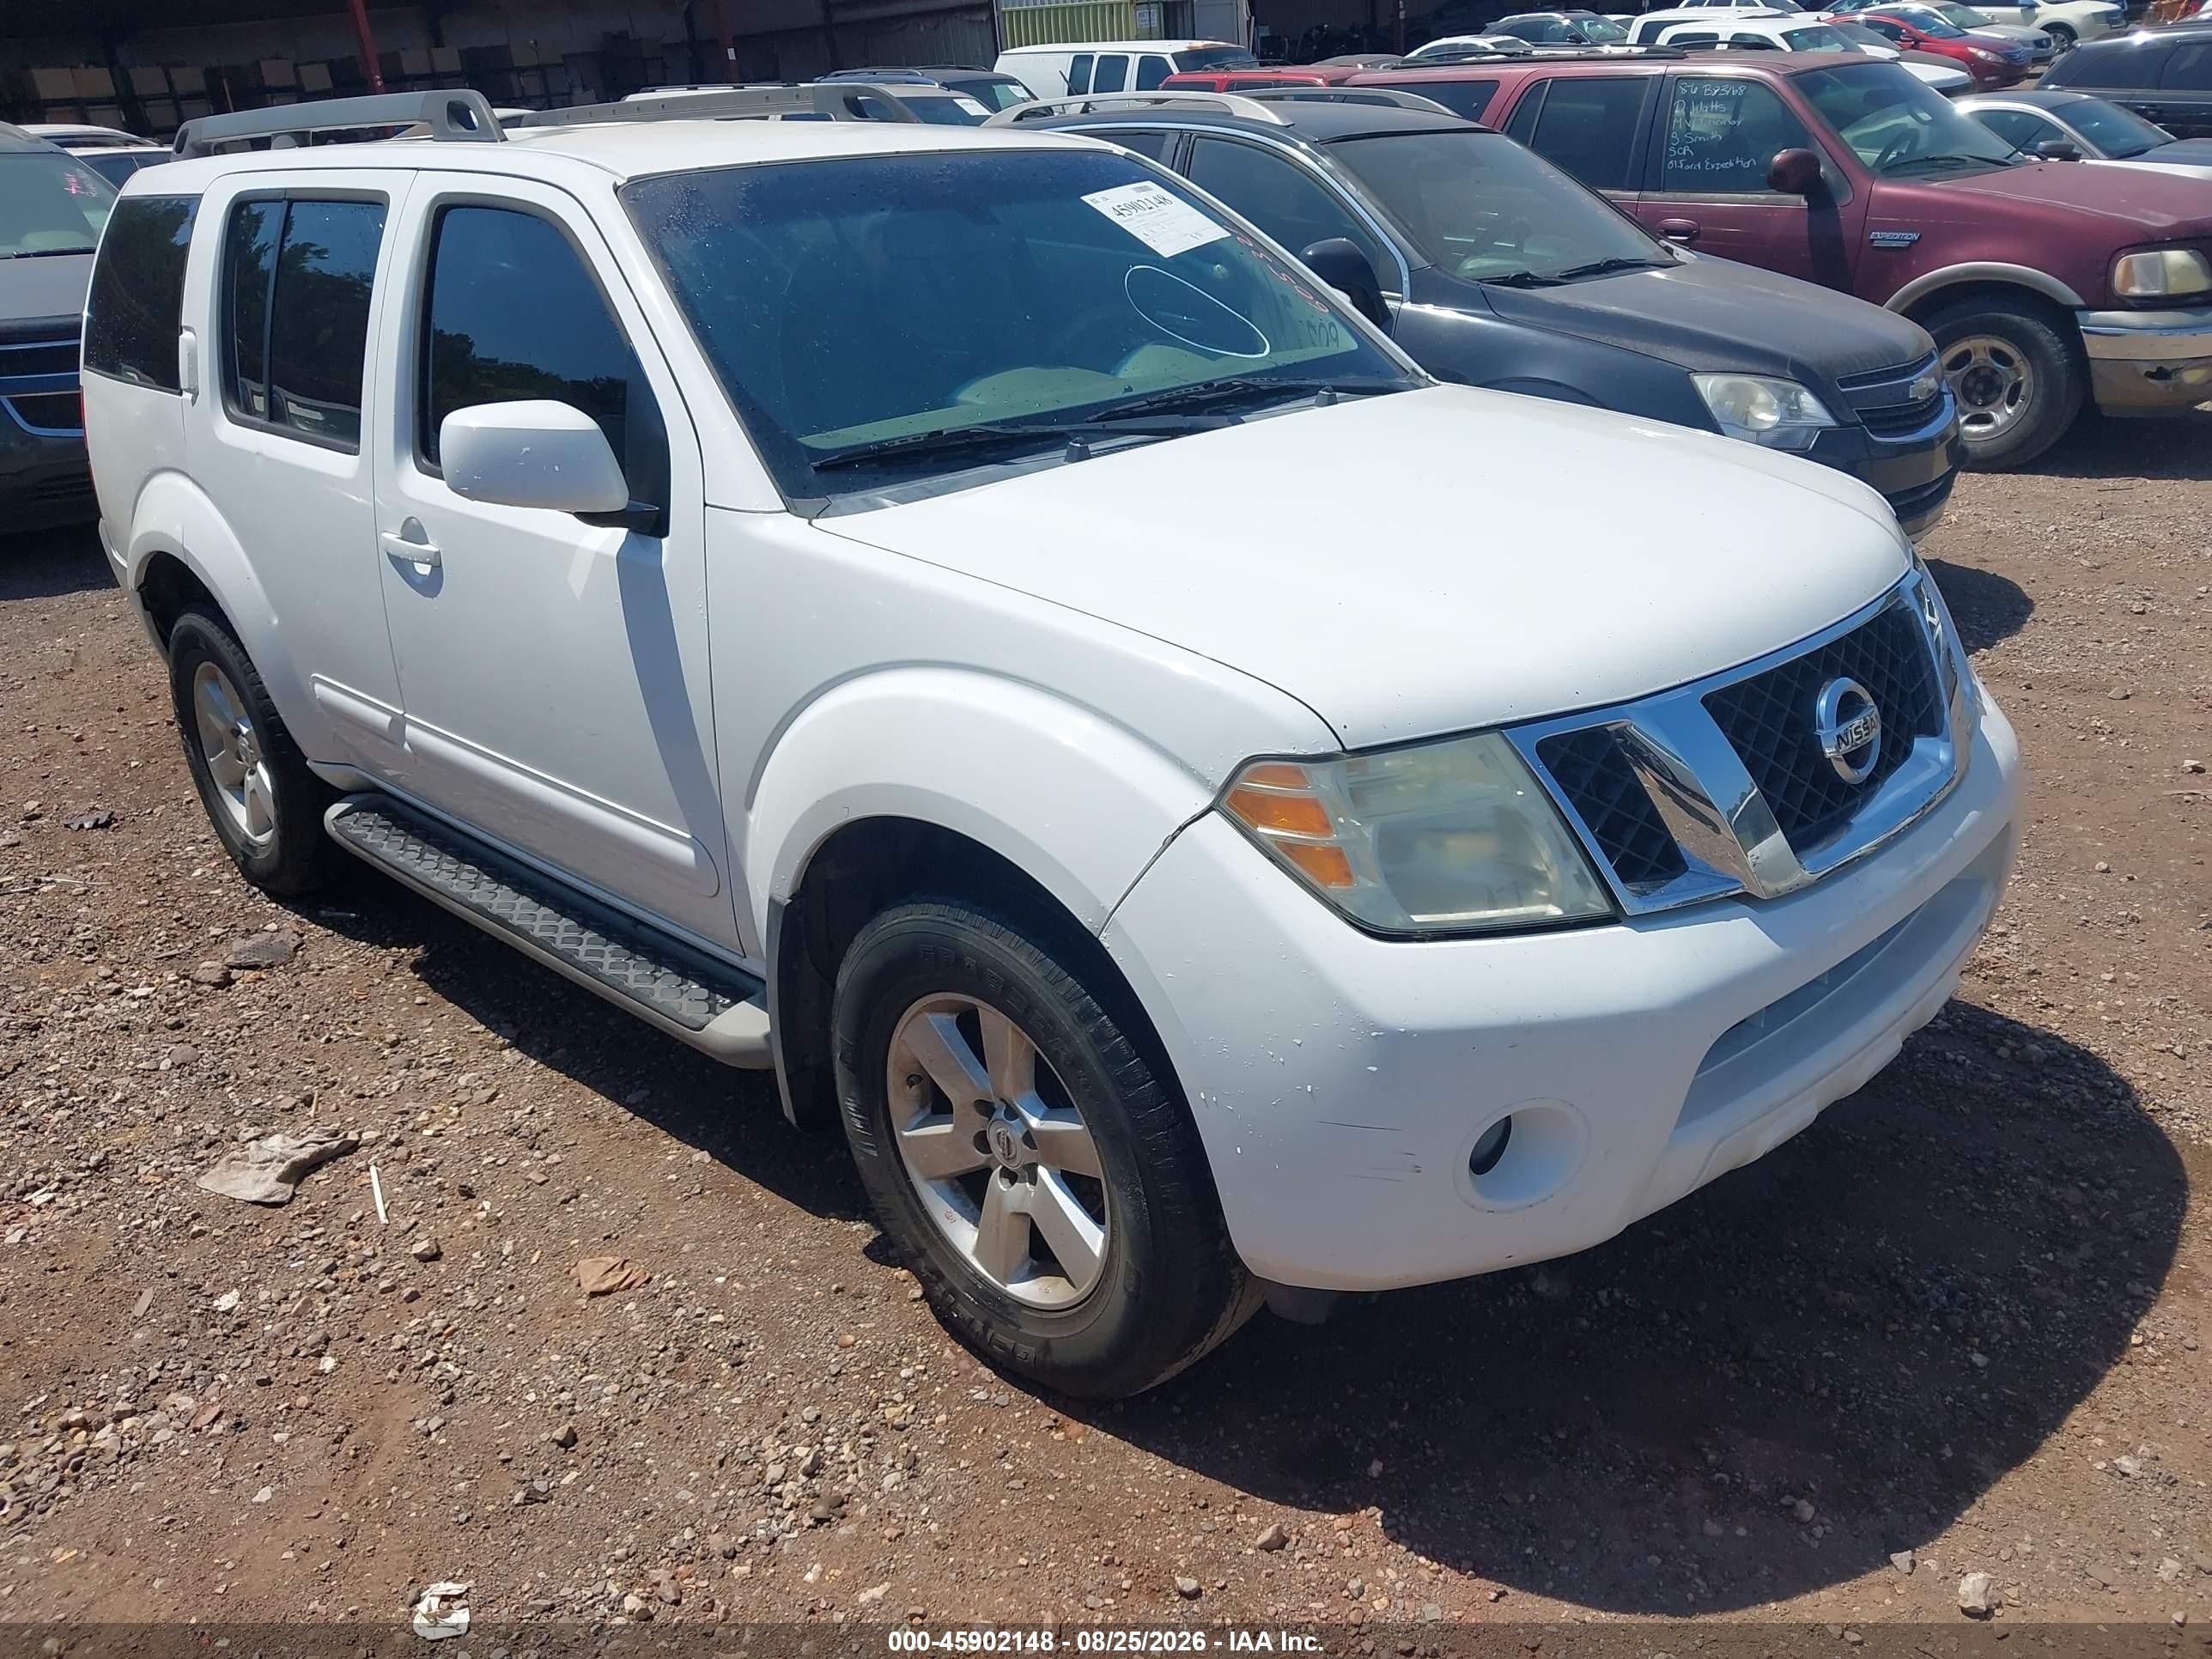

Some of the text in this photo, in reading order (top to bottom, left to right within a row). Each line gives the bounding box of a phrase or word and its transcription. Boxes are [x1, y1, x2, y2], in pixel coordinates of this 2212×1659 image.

[1111, 194, 1174, 218] 45902148
[1869, 232, 1920, 240] EXPEDITION
[1836, 714, 1878, 752] NISSA
